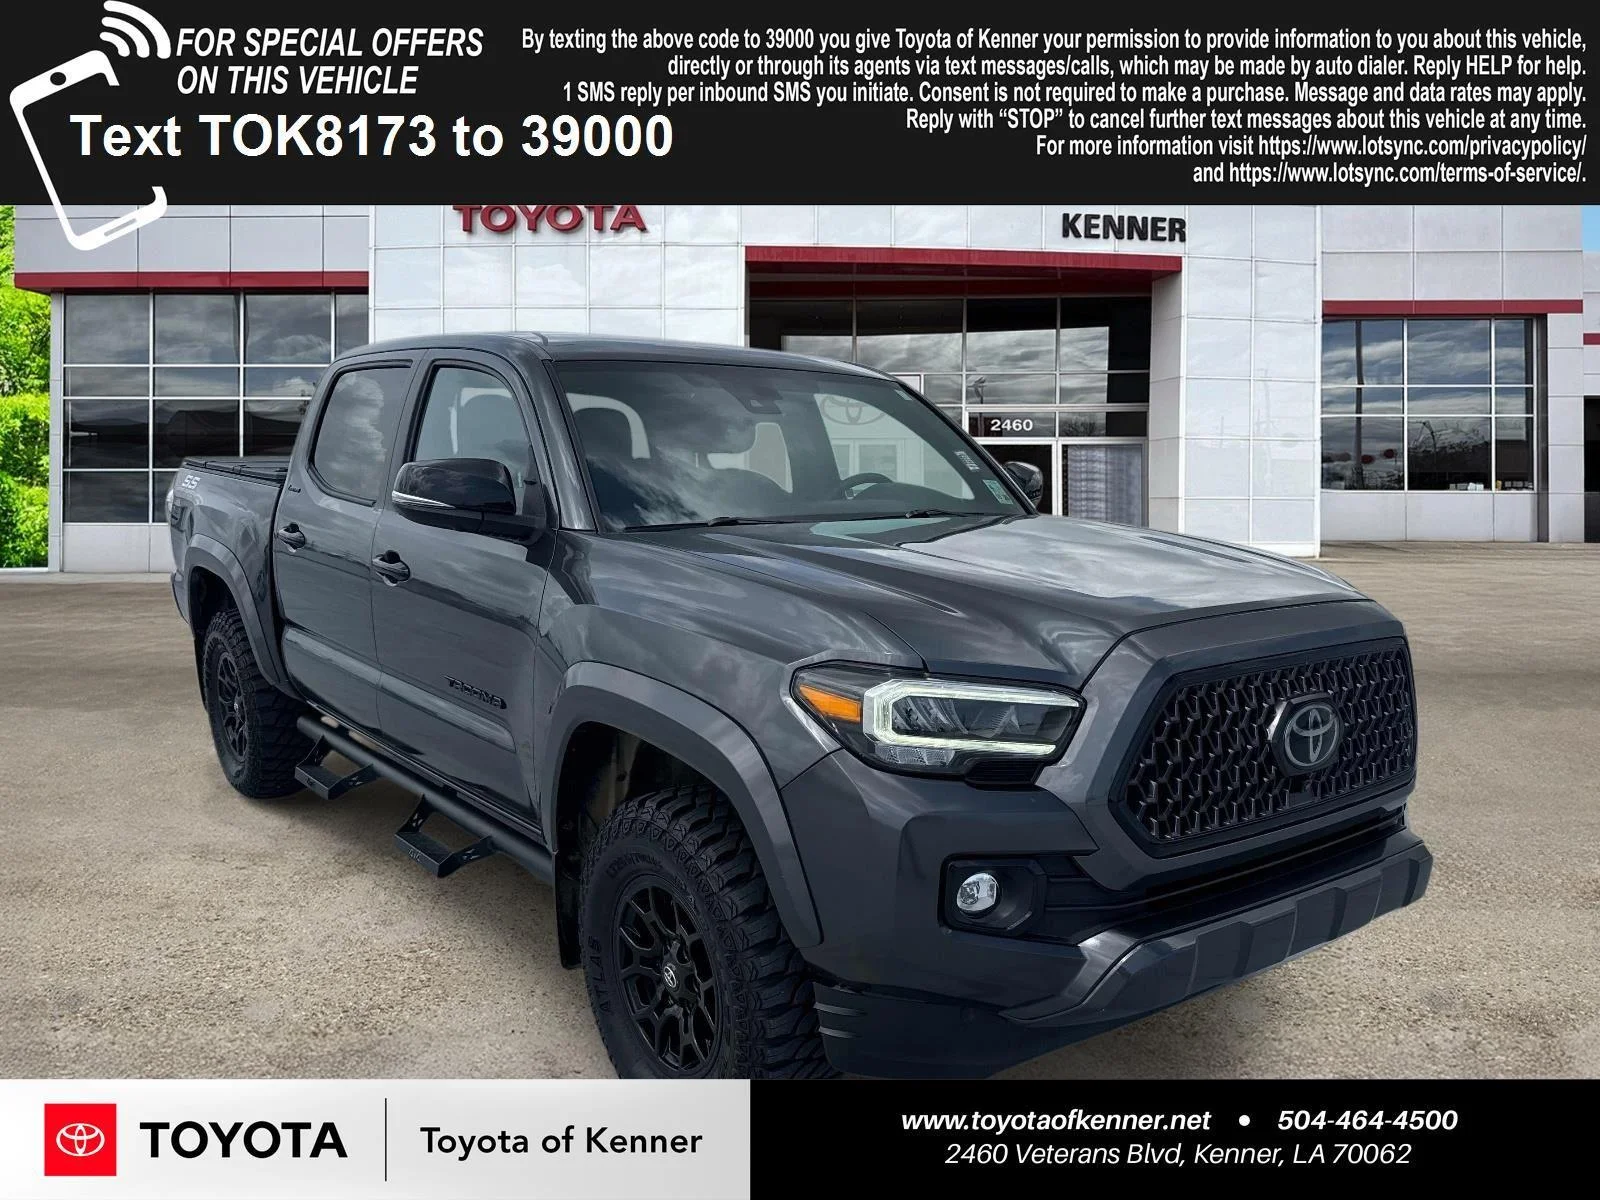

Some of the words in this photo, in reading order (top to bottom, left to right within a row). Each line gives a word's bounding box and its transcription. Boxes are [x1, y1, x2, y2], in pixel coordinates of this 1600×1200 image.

[453, 205, 647, 232] TOYOTA
[1061, 212, 1186, 242] KENNER
[990, 419, 1033, 431] 2460
